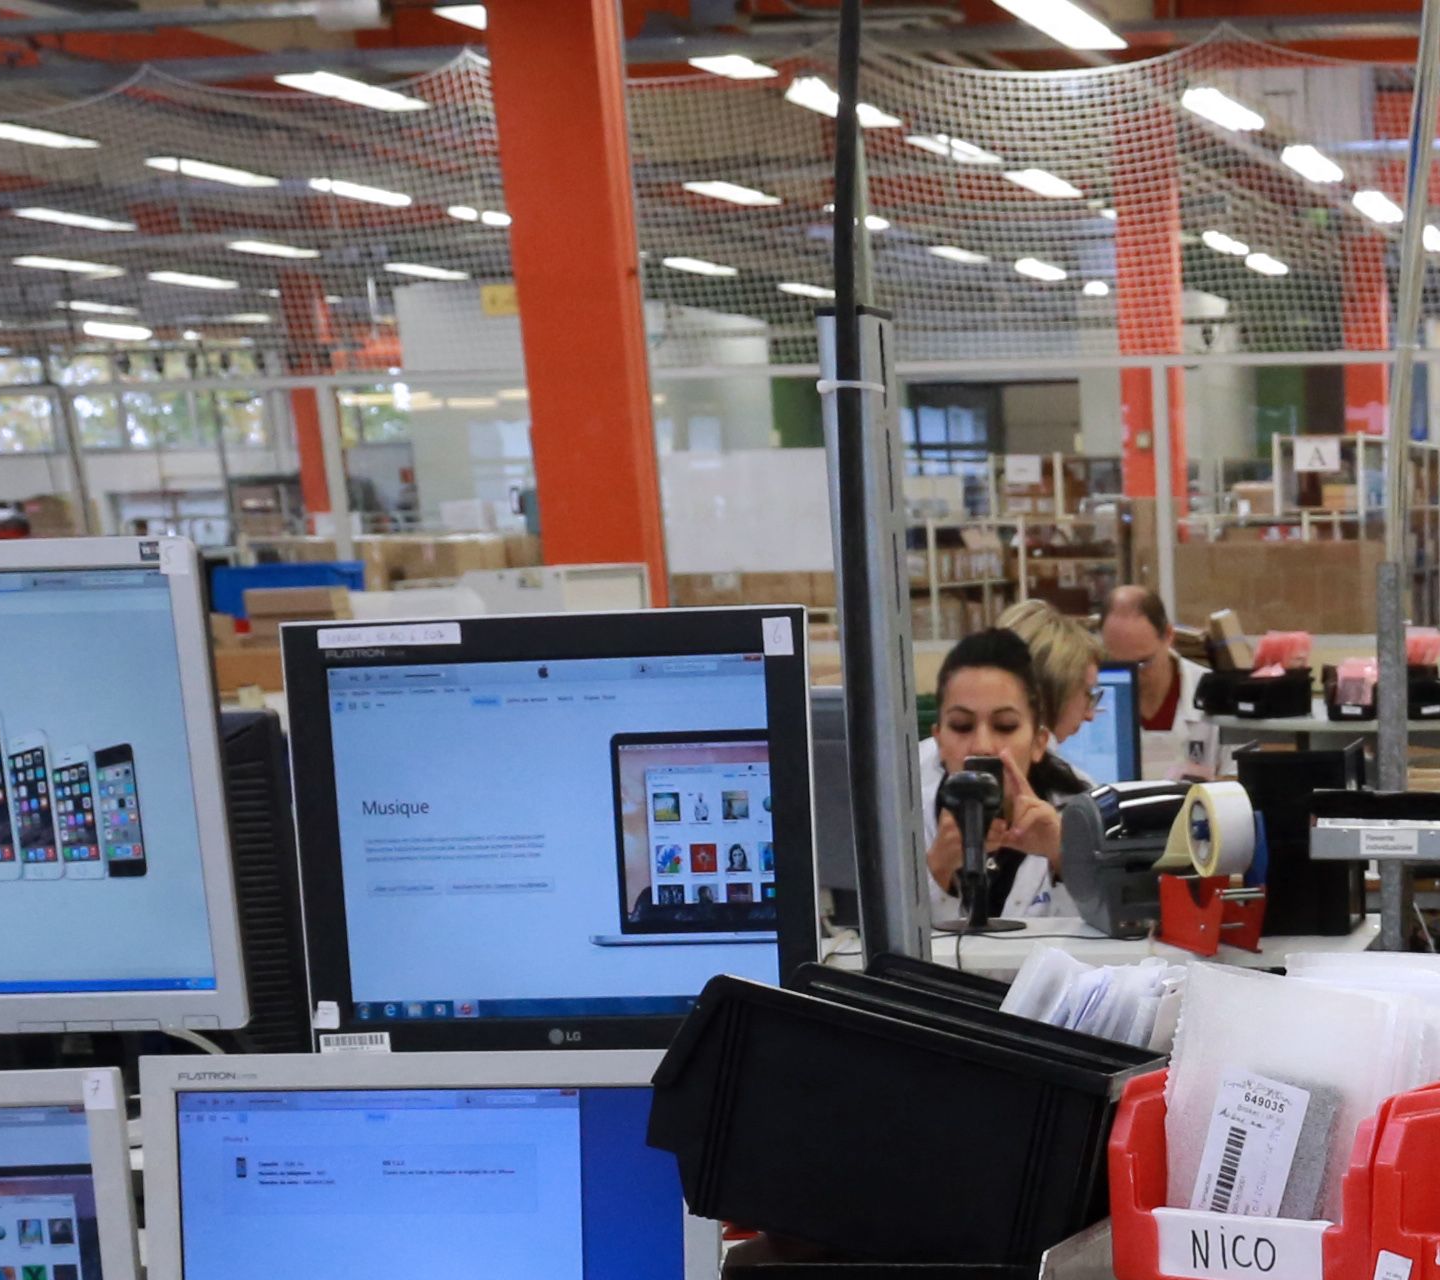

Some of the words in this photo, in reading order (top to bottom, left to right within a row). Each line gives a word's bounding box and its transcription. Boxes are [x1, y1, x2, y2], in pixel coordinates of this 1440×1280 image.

[1307, 445, 1326, 467] A
[362, 799, 430, 818] Musique
[566, 1032, 581, 1041] LG
[177, 1071, 237, 1081] FLATRON
[1243, 1092, 1286, 1114] 649035
